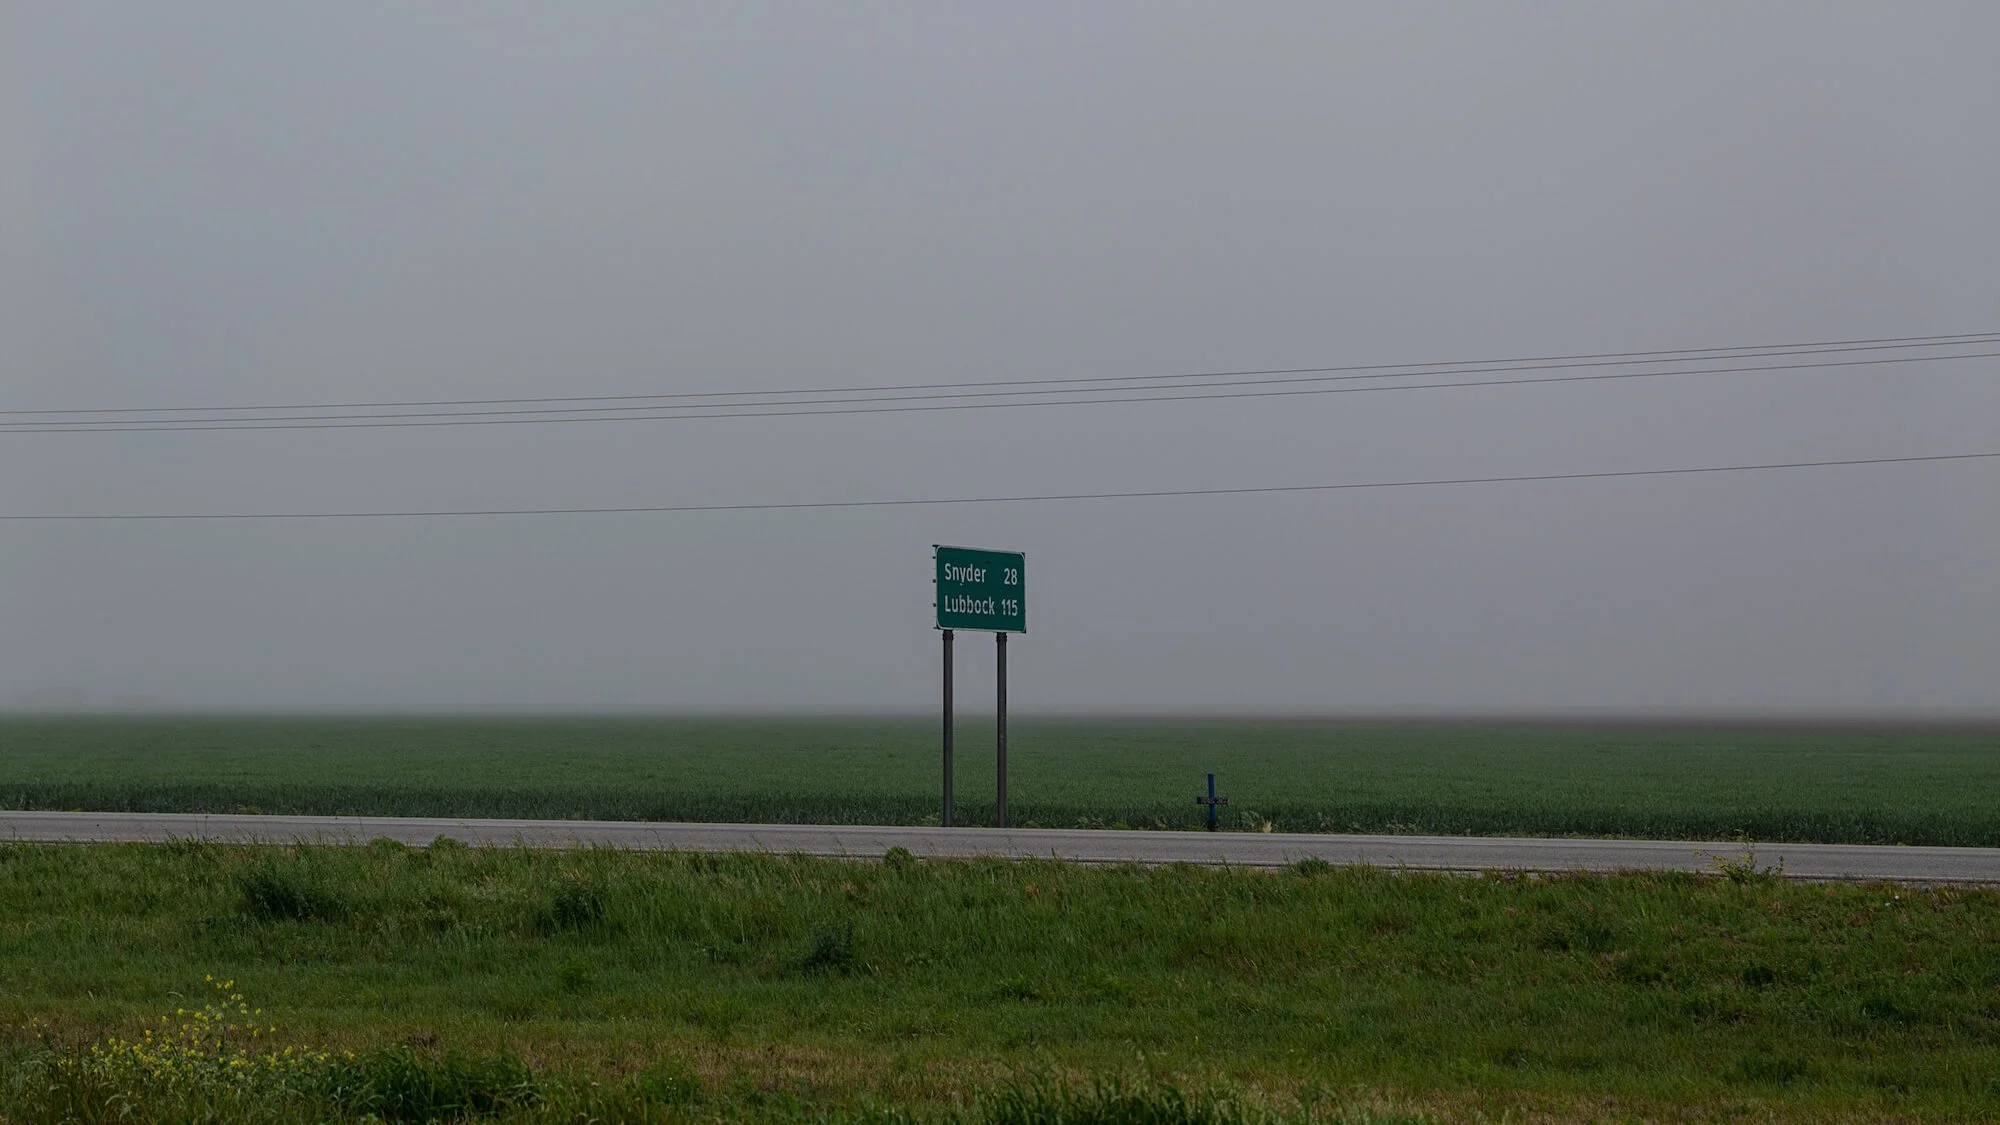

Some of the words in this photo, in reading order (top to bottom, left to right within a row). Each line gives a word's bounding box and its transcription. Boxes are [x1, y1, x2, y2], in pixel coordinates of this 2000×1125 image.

[944, 563, 987, 586] Snyder
[1003, 567, 1018, 585] 28
[944, 595, 995, 615] Lubbock
[1001, 598, 1018, 617] 115
